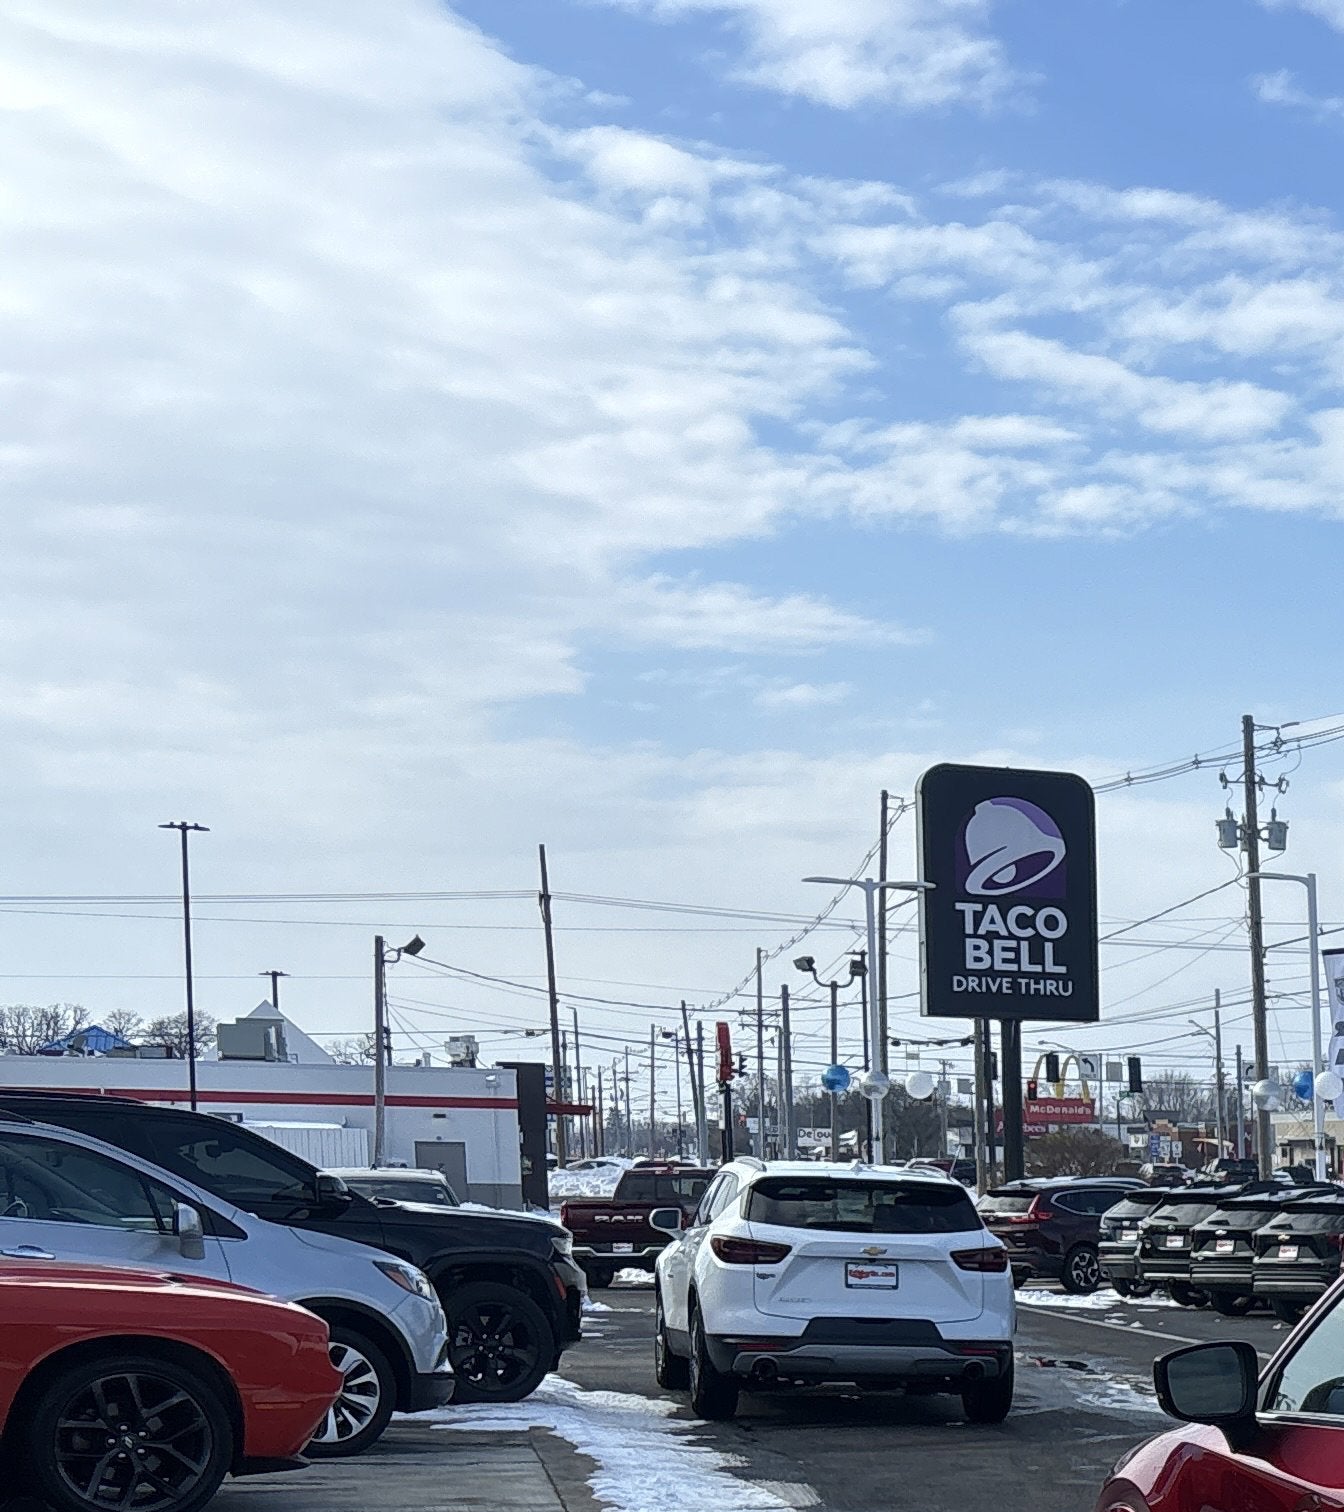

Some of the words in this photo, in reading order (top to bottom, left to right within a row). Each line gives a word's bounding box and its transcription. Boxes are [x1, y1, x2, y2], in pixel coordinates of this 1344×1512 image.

[954, 902, 1068, 939] TACO
[965, 937, 1067, 974] BELL
[952, 975, 1013, 994] DRIVE
[1017, 978, 1073, 997] THRU
[1029, 1104, 1092, 1115] McDonald's
